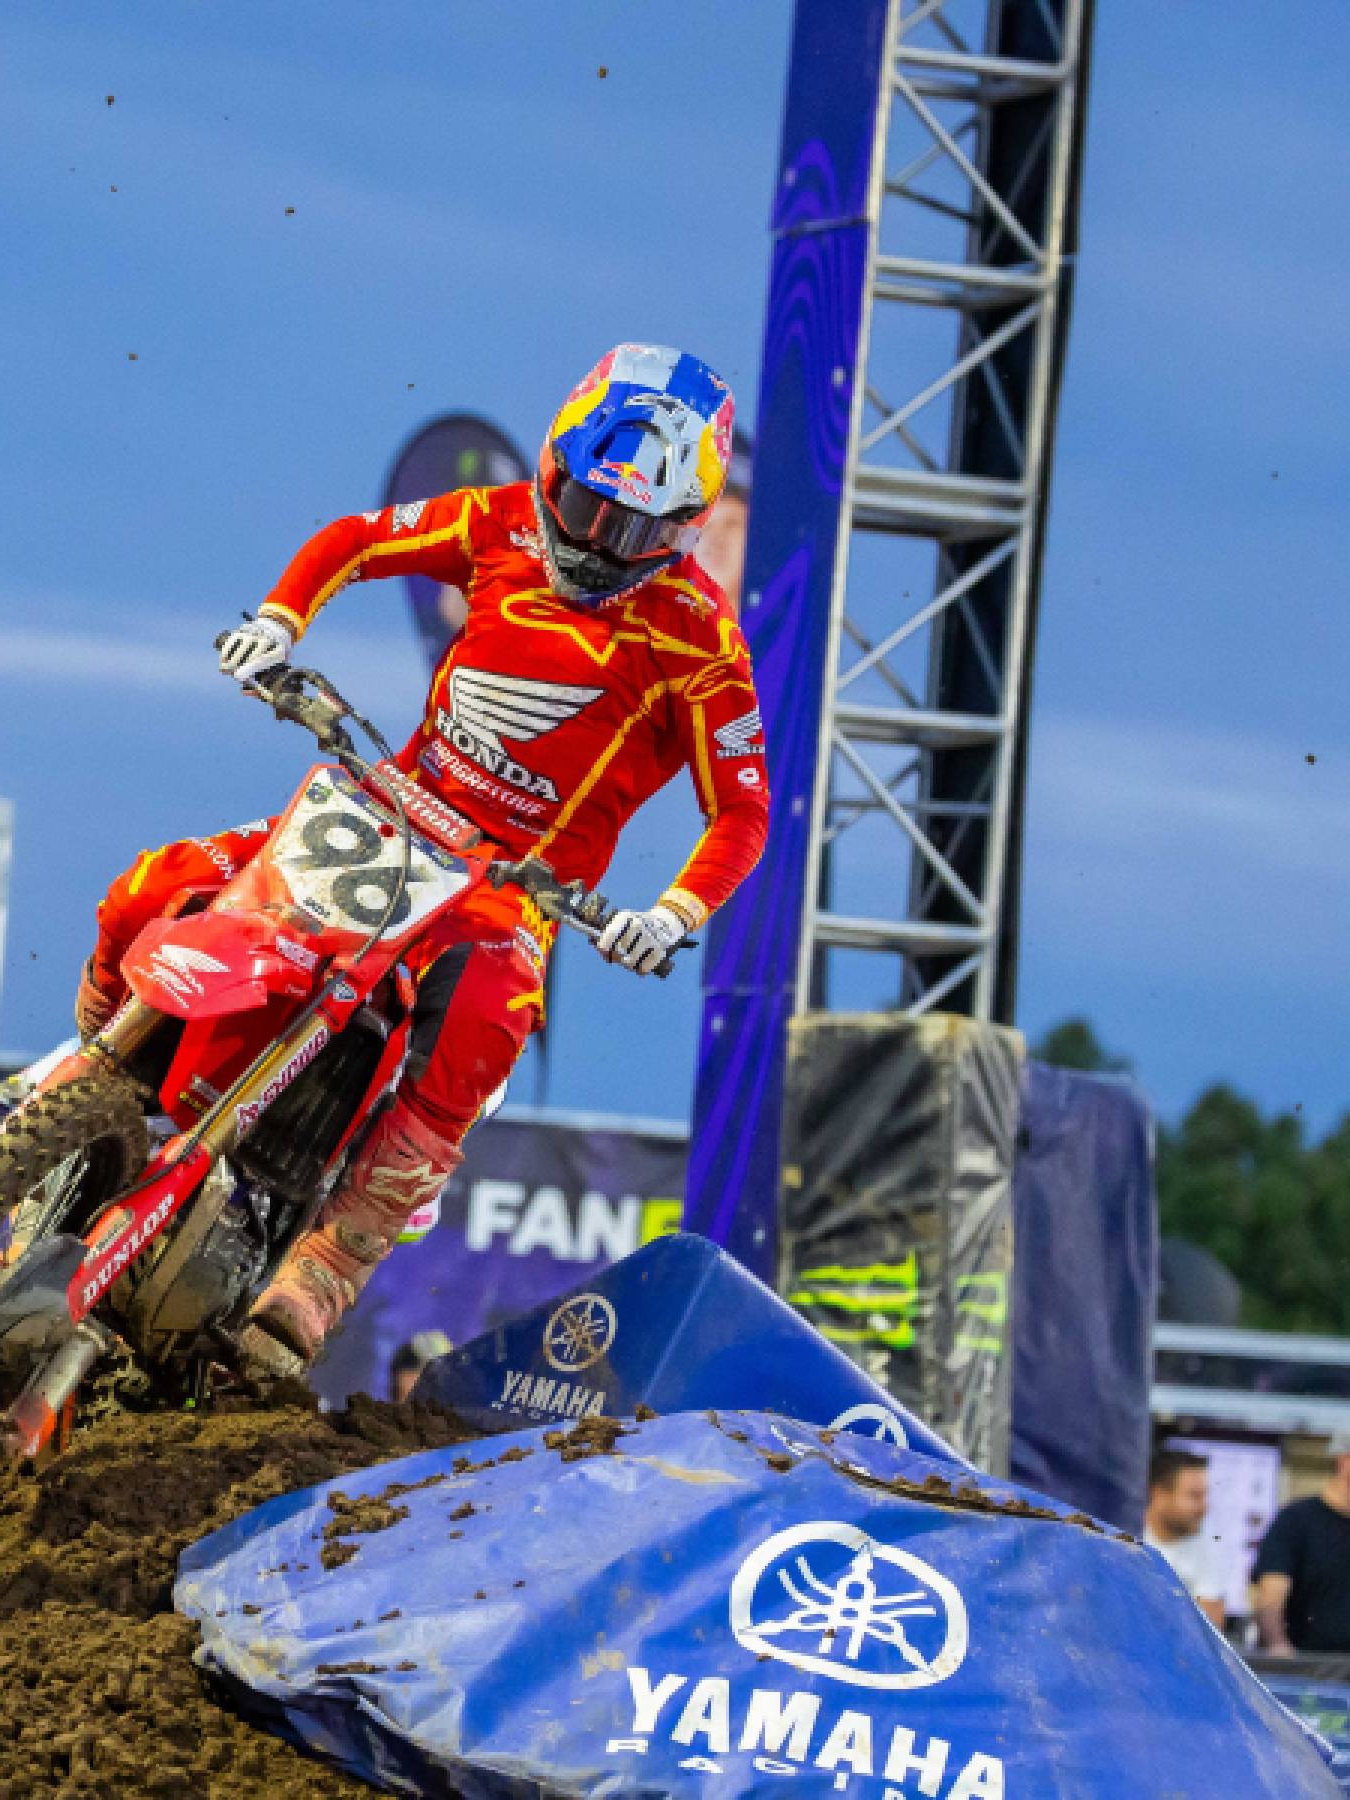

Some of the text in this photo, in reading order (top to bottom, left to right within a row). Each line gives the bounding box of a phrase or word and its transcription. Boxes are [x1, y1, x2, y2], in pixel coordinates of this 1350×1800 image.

[434, 706, 563, 802] HONDA
[83, 1193, 174, 1305] DUNLOP
[500, 1369, 607, 1418] YAMAHA
[626, 1667, 1004, 1800] YAMAHA
